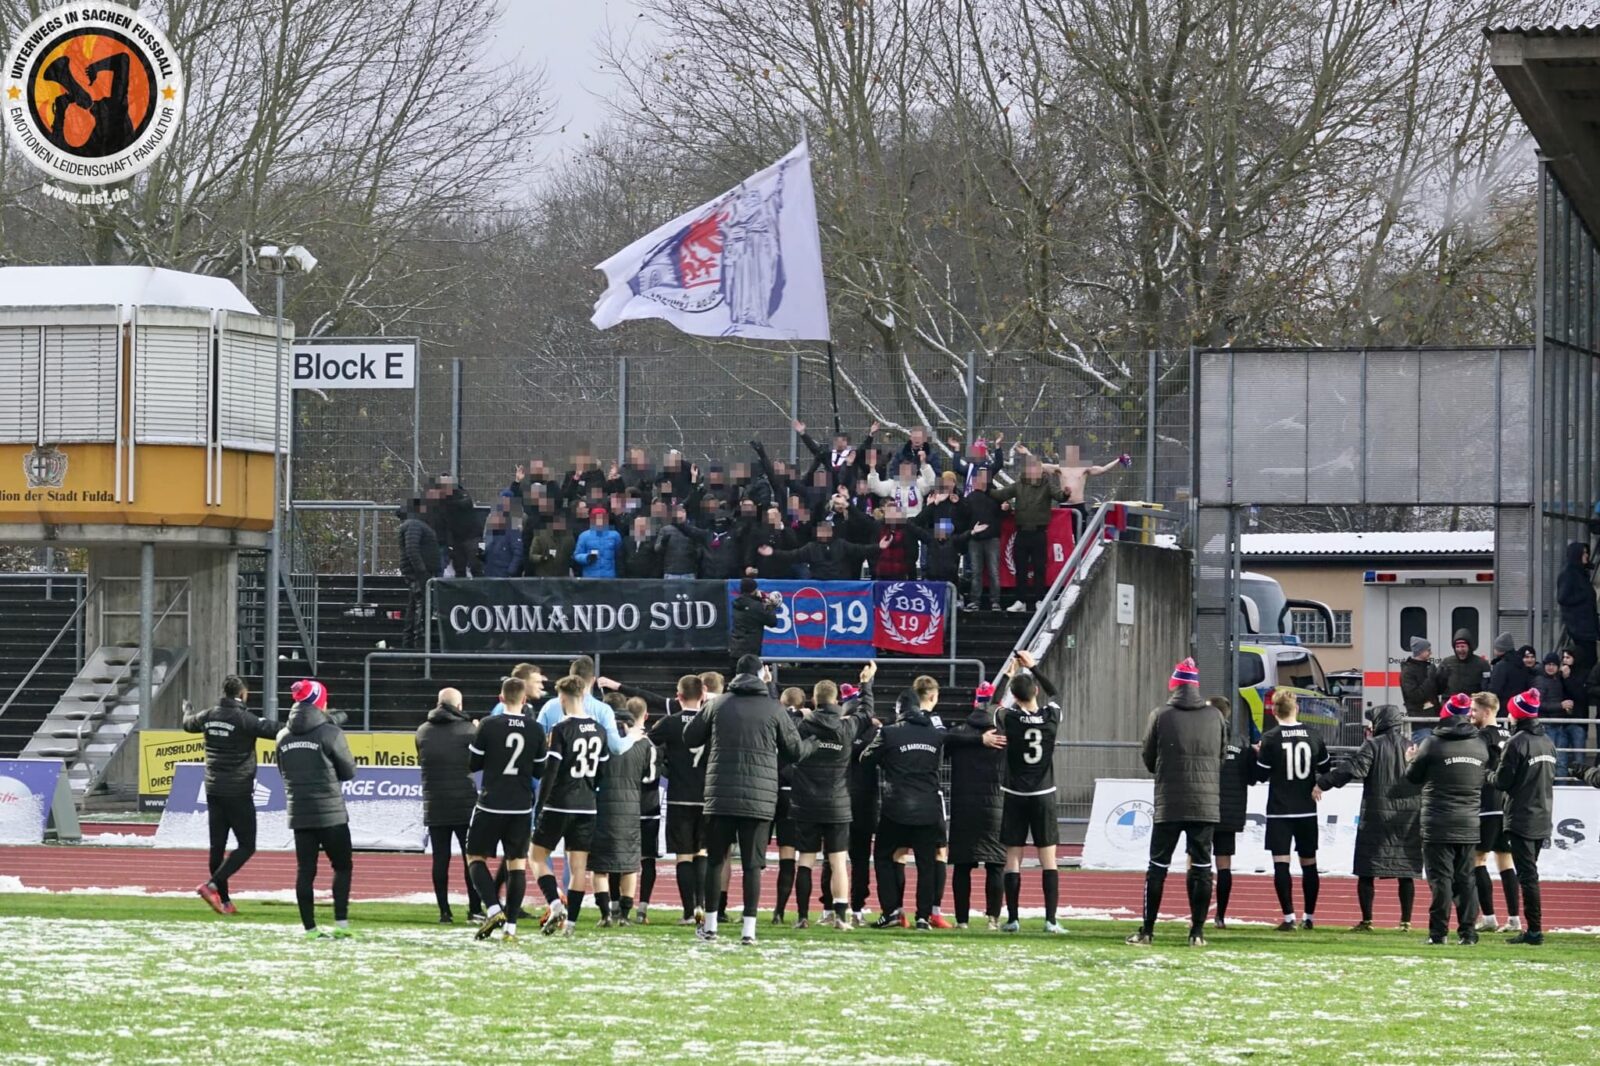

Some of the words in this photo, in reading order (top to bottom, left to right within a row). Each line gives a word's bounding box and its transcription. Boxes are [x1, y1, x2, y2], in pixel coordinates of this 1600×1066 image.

[294, 352, 377, 380] Block
[385, 352, 404, 380] E
[25, 490, 43, 501] der
[47, 490, 78, 502] Stadt
[82, 490, 115, 502] Fulda
[450, 603, 641, 635] COMMANDO
[650, 594, 718, 631] SÜD
[895, 596, 926, 612] BB
[829, 600, 869, 634] 19
[899, 614, 919, 632] 19
[155, 743, 205, 757] AUSBILDUN
[502, 732, 525, 775] 2
[570, 736, 602, 778] 33
[1023, 728, 1043, 764] 3
[263, 751, 277, 764] M
[354, 756, 369, 766] m
[1281, 741, 1312, 780] 10
[151, 776, 174, 787] DIRE
[341, 781, 375, 796] RGE
